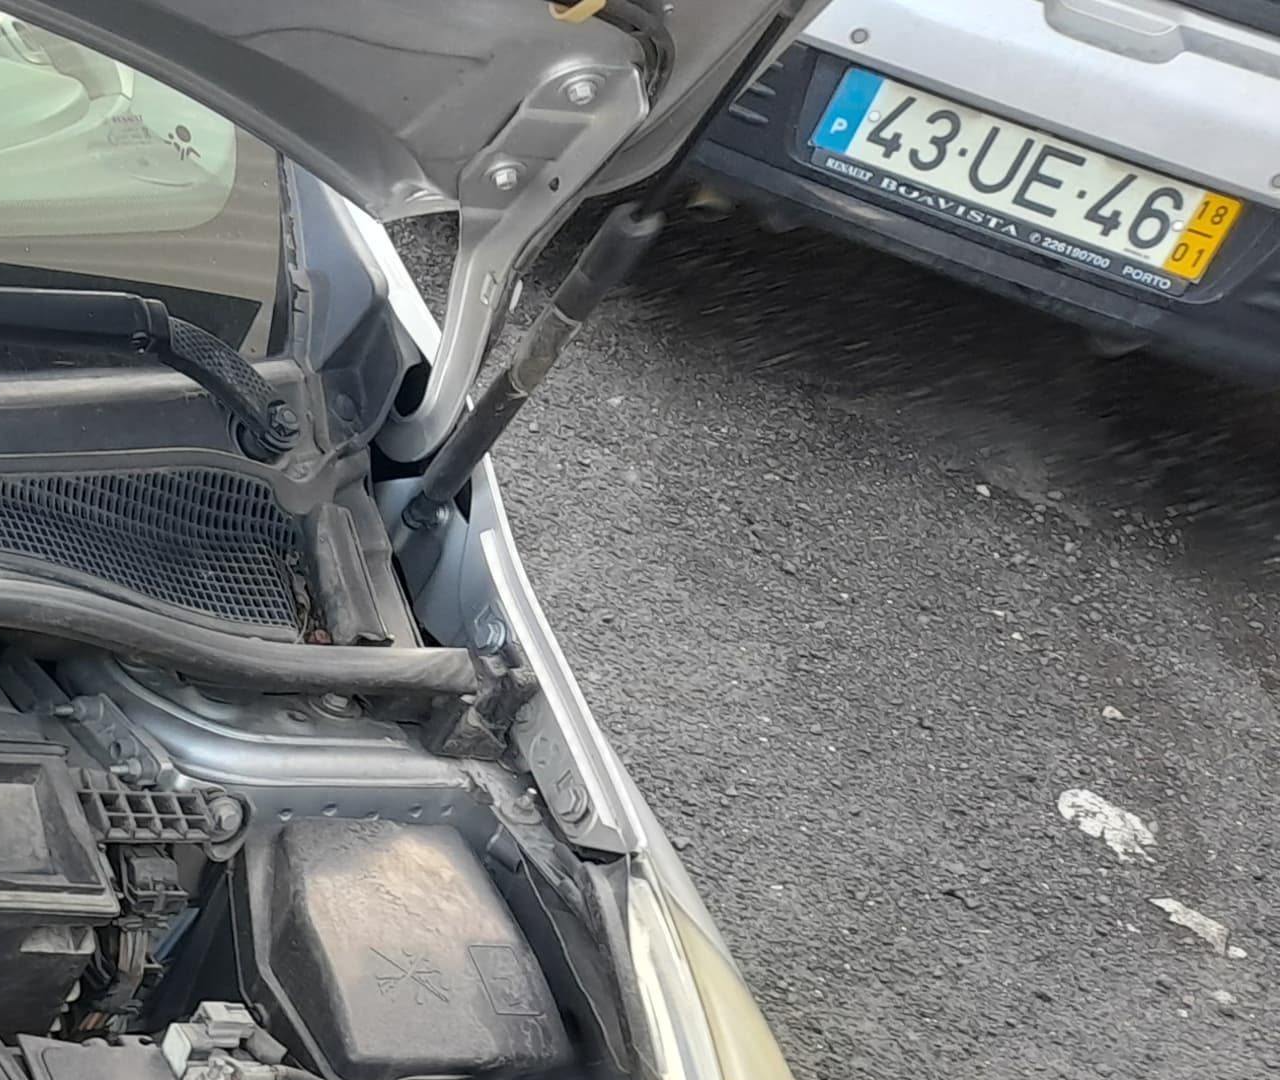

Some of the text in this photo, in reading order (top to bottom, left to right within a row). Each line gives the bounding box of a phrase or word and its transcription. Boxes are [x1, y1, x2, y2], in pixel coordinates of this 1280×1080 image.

[830, 117, 848, 135] P
[825, 157, 874, 182] RENAULT
[880, 176, 1019, 237] BOAVISTA
[1041, 236, 1110, 269] 226190700
[1122, 264, 1171, 290] PORTO
[1197, 200, 1229, 227] 18
[1171, 242, 1207, 269] 01
